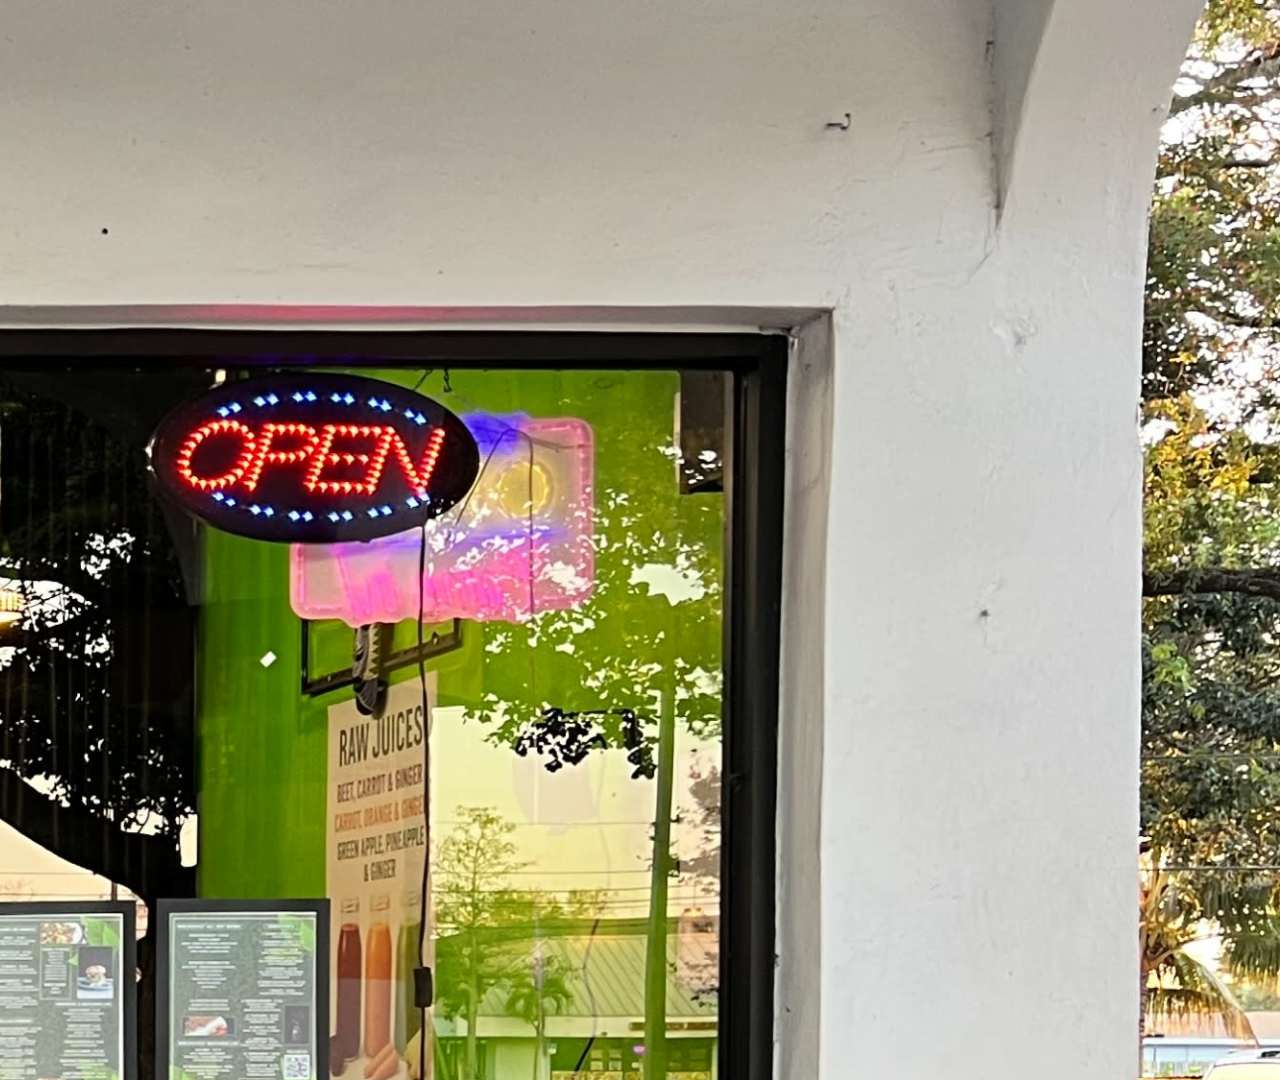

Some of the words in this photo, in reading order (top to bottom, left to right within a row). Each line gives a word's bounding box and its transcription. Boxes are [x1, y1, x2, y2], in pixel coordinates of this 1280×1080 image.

[177, 419, 446, 496] OPEN
[340, 722, 369, 766] RAW
[372, 705, 422, 758] JUICES
